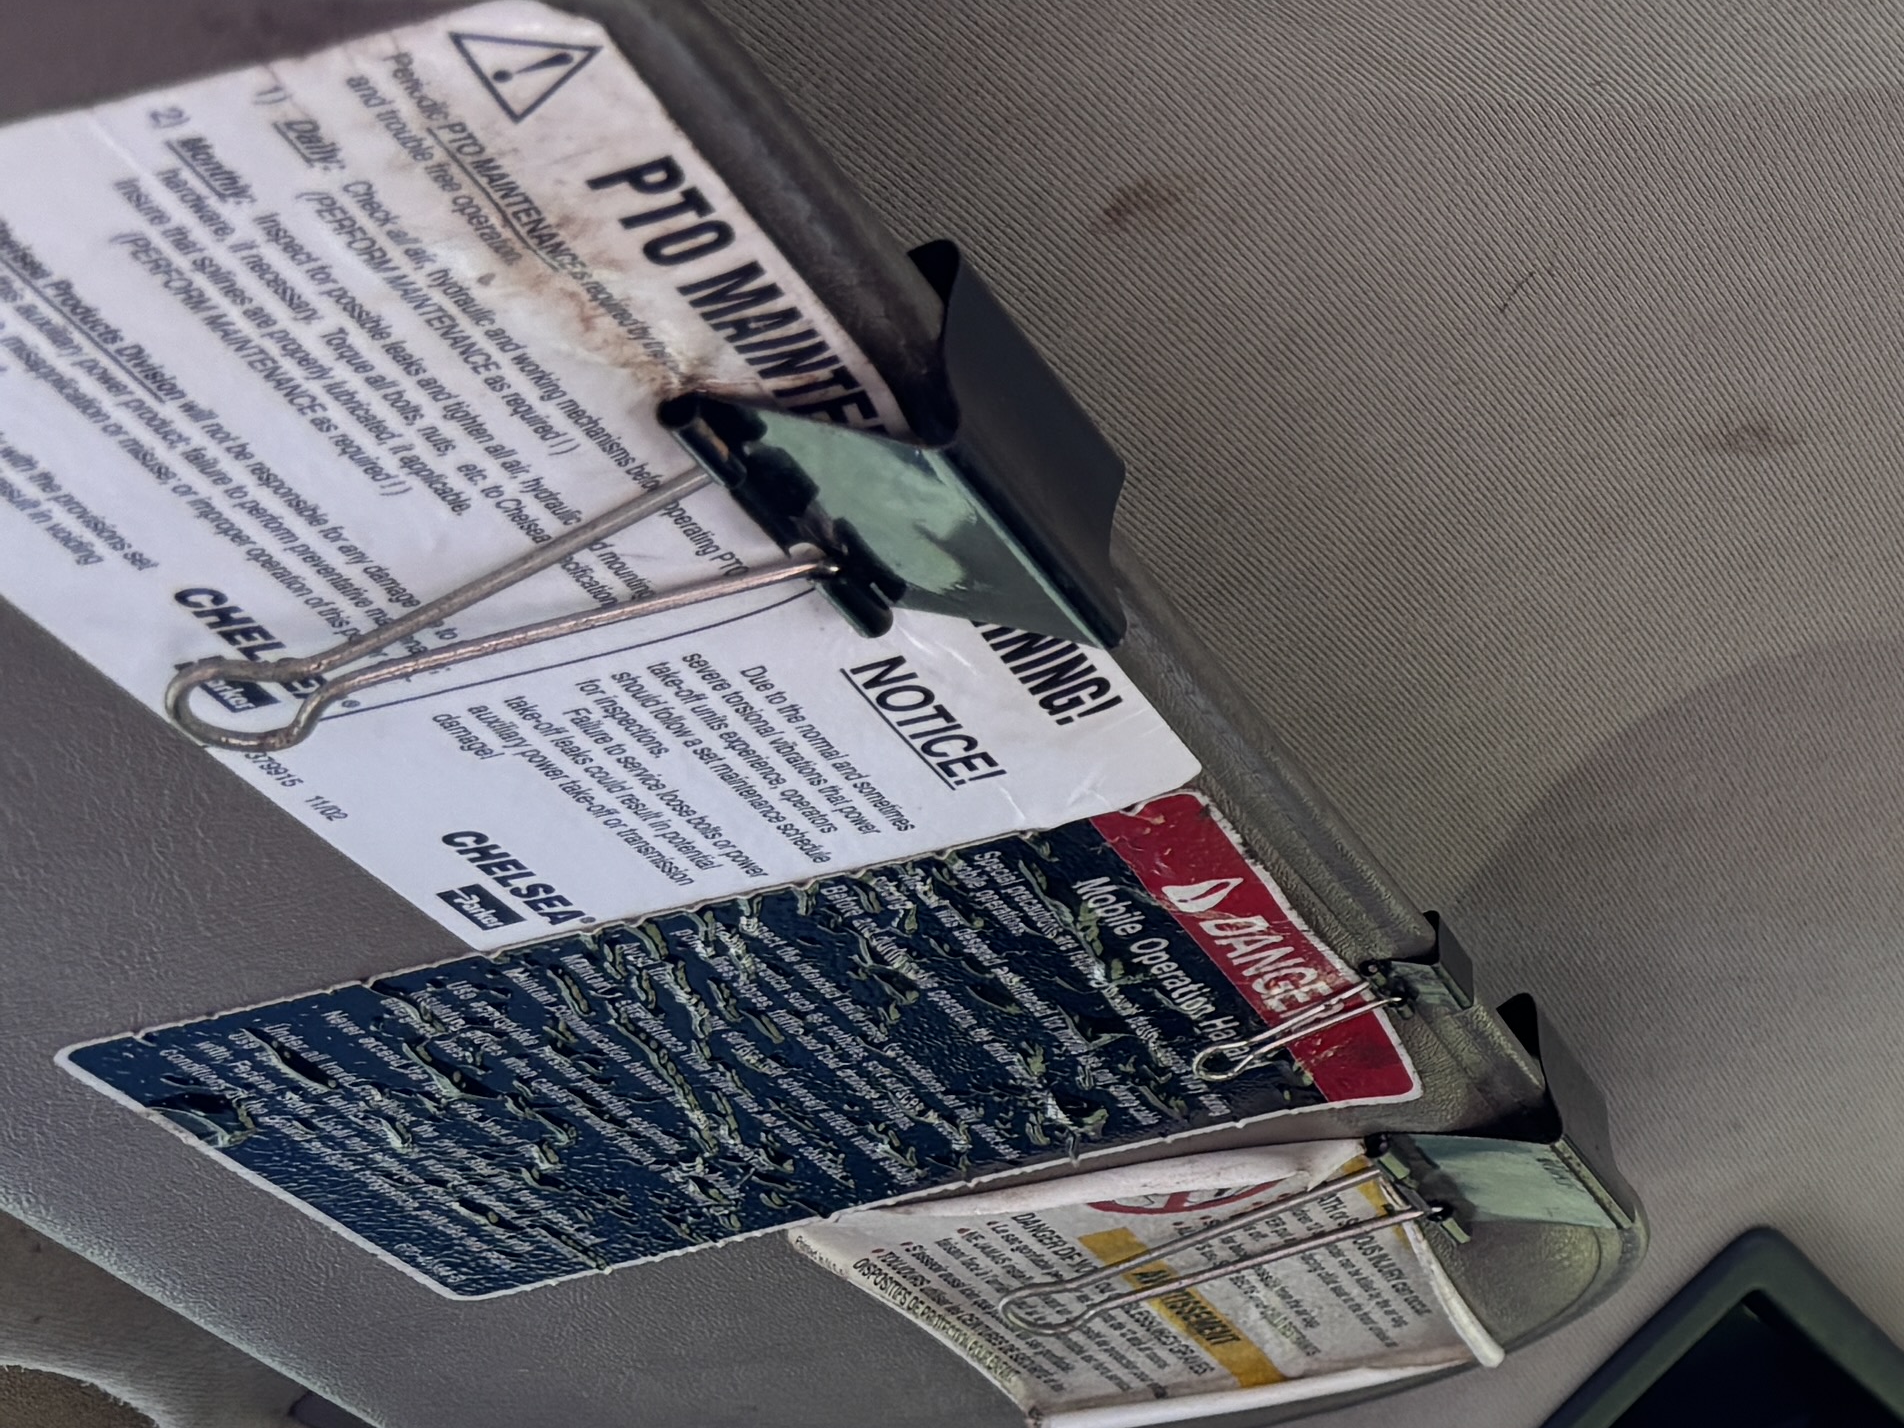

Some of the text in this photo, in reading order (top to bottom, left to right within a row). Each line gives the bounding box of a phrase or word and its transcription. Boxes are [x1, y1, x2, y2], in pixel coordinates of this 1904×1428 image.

[346, 76, 393, 108] and
[376, 109, 434, 162] trouble
[425, 162, 462, 193] free
[437, 122, 485, 157] PTO
[460, 157, 578, 266] MAINTENANCE
[586, 155, 735, 266] PTO
[162, 226, 471, 516] that splines are properly lubricated, applicable.
[203, 314, 338, 432] MAINTENANCE as
[297, 192, 400, 273] (PERFORM
[385, 274, 501, 375] MAINTENANCE
[484, 375, 511, 392] as
[342, 181, 399, 227] Check
[385, 229, 420, 246] all
[427, 269, 495, 327] hydraulic
[484, 328, 527, 353] and
[511, 352, 567, 402] working
[556, 398, 636, 468] mechanisms
[72, 359, 374, 608] power failure to perform preventative
[114, 344, 421, 608] Division not be responsible for any damage
[254, 213, 664, 601] Inspect for possible leaks and tighten all air, hydraulic mounting
[320, 327, 562, 545] Torque all bolts, nuts, etc. to Chelsea
[46, 494, 158, 571] provisions set
[101, 423, 350, 629] or or improper operation of this
[432, 714, 505, 760] damage!
[467, 705, 695, 886] auxiliary power take-off or transmission
[503, 696, 723, 870] take-off leaks could result in potential
[562, 707, 769, 877] Failure to service loose bolts or power
[575, 679, 670, 759] for inspections.
[610, 672, 831, 863] should follow a set maintenance schedule
[646, 662, 838, 834] take-off units experience, operators
[682, 653, 881, 834] severe torsional vibrations that power
[740, 665, 915, 831] Due to the normal and sometimes
[850, 655, 1006, 786] NOTICE!
[305, 795, 348, 821] 11/02
[453, 894, 504, 927] Parker
[1072, 877, 1145, 935] Mobile
[1129, 938, 1215, 1020] Operation
